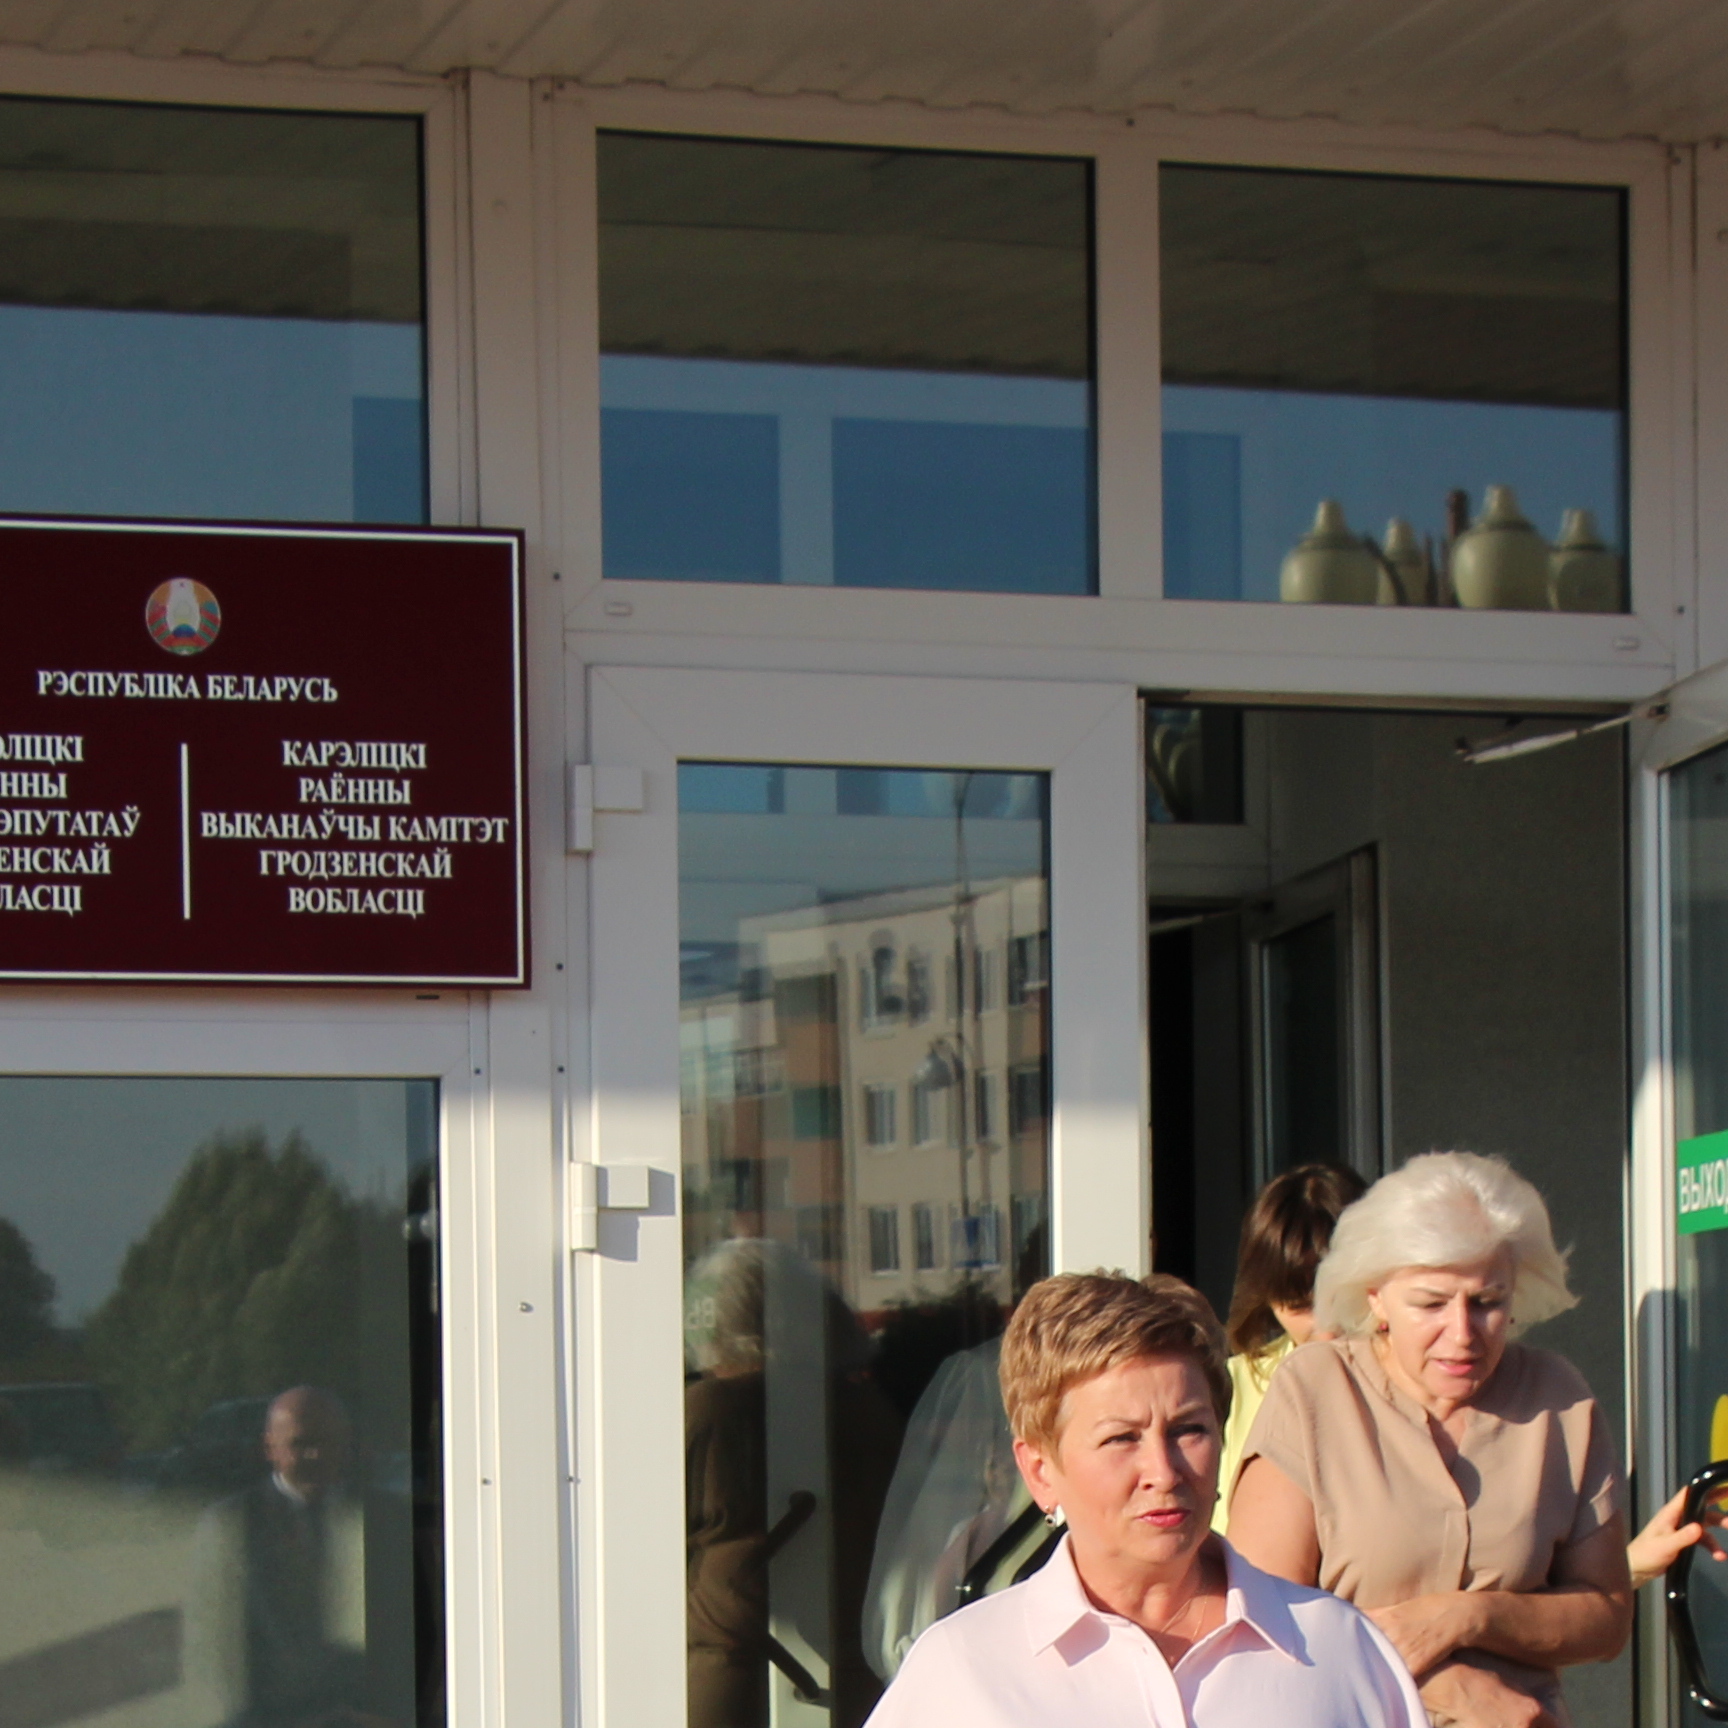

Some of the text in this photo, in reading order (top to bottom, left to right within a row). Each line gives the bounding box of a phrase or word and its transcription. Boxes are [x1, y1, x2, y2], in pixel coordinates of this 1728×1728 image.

[37, 670, 339, 702] РЭСПУБЛІКА БЕЛАРУСЬ
[282, 740, 427, 771] КАРЭЛІЦКІ
[299, 772, 411, 805] РАЁННЫ
[201, 809, 509, 843] ВЫКАНАЎЧЫ КАМІТЭТ
[259, 845, 453, 881] ГРОДЗЕНСКАЙ
[288, 887, 425, 919] ВОБЛАСЦІ
